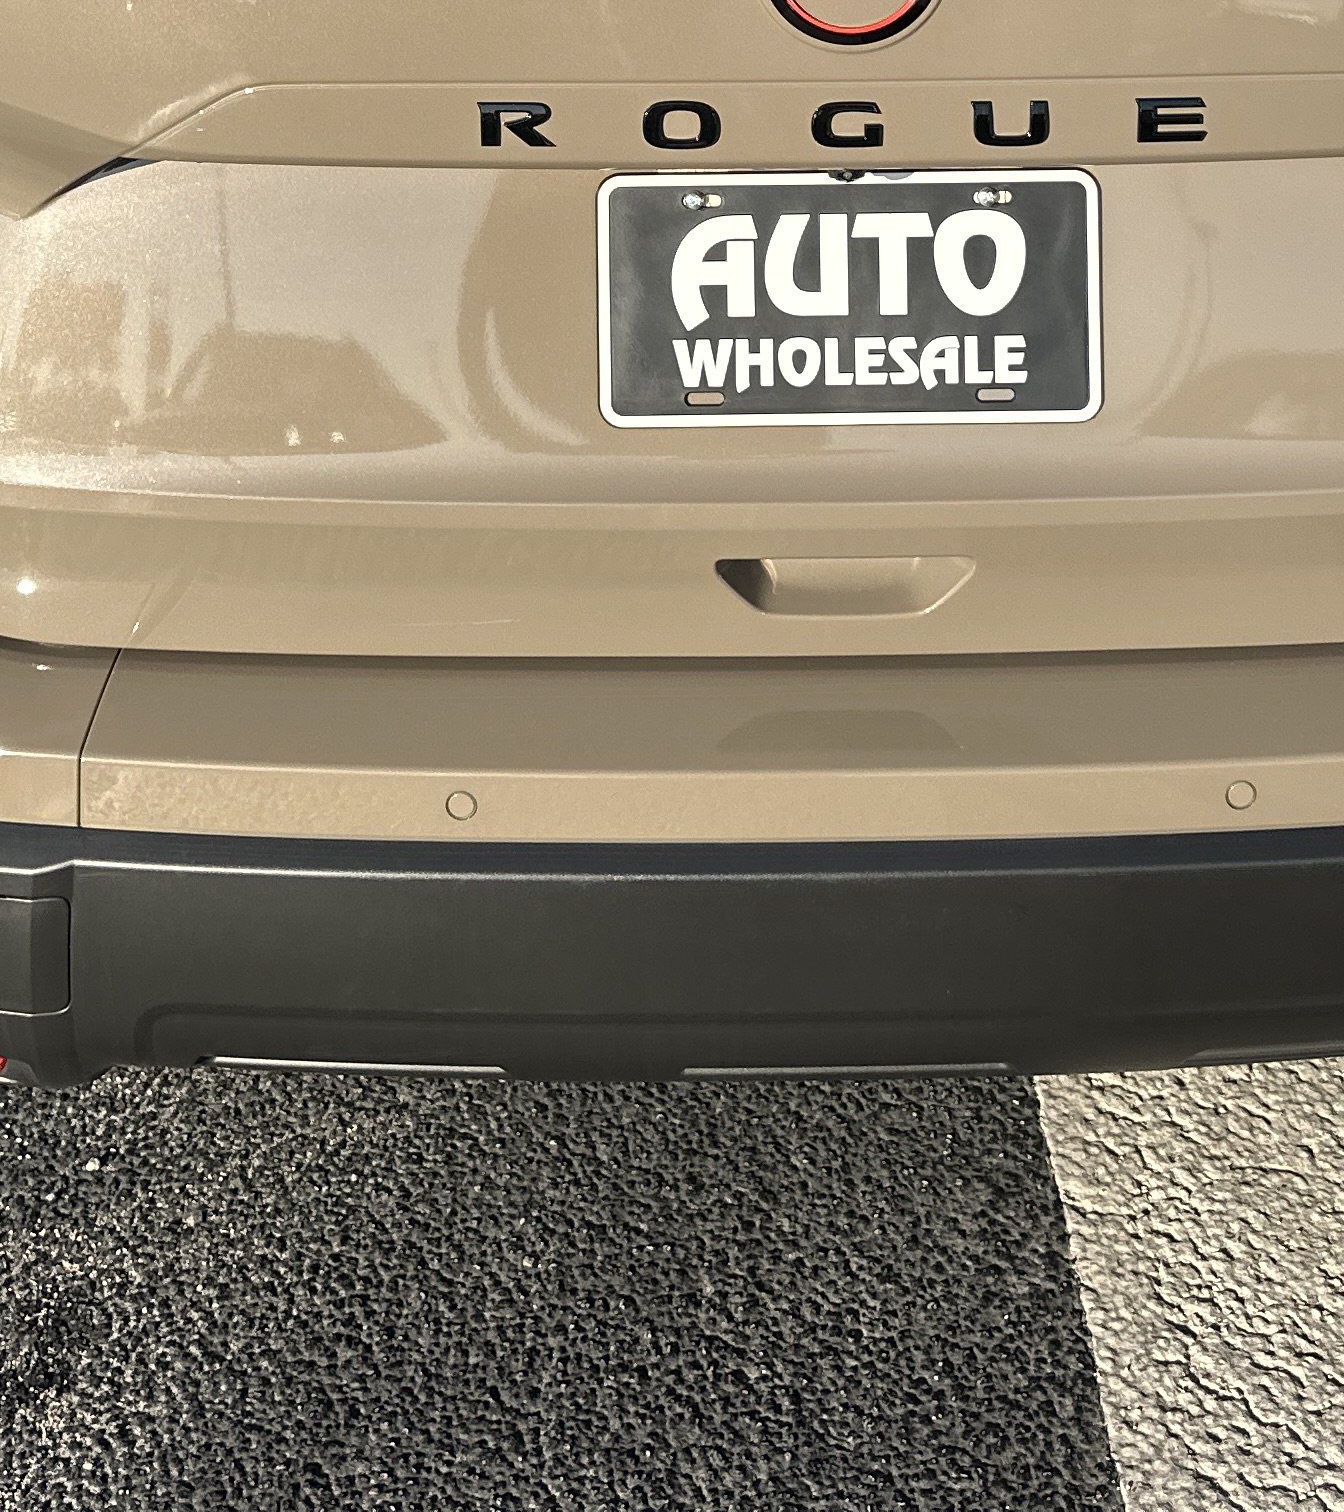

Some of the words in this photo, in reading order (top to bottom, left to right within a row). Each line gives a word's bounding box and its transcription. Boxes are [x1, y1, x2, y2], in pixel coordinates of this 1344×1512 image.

[476, 96, 1210, 149] ROGUE
[670, 208, 1027, 332] AUTO
[671, 334, 1029, 393] WHOLESALE
